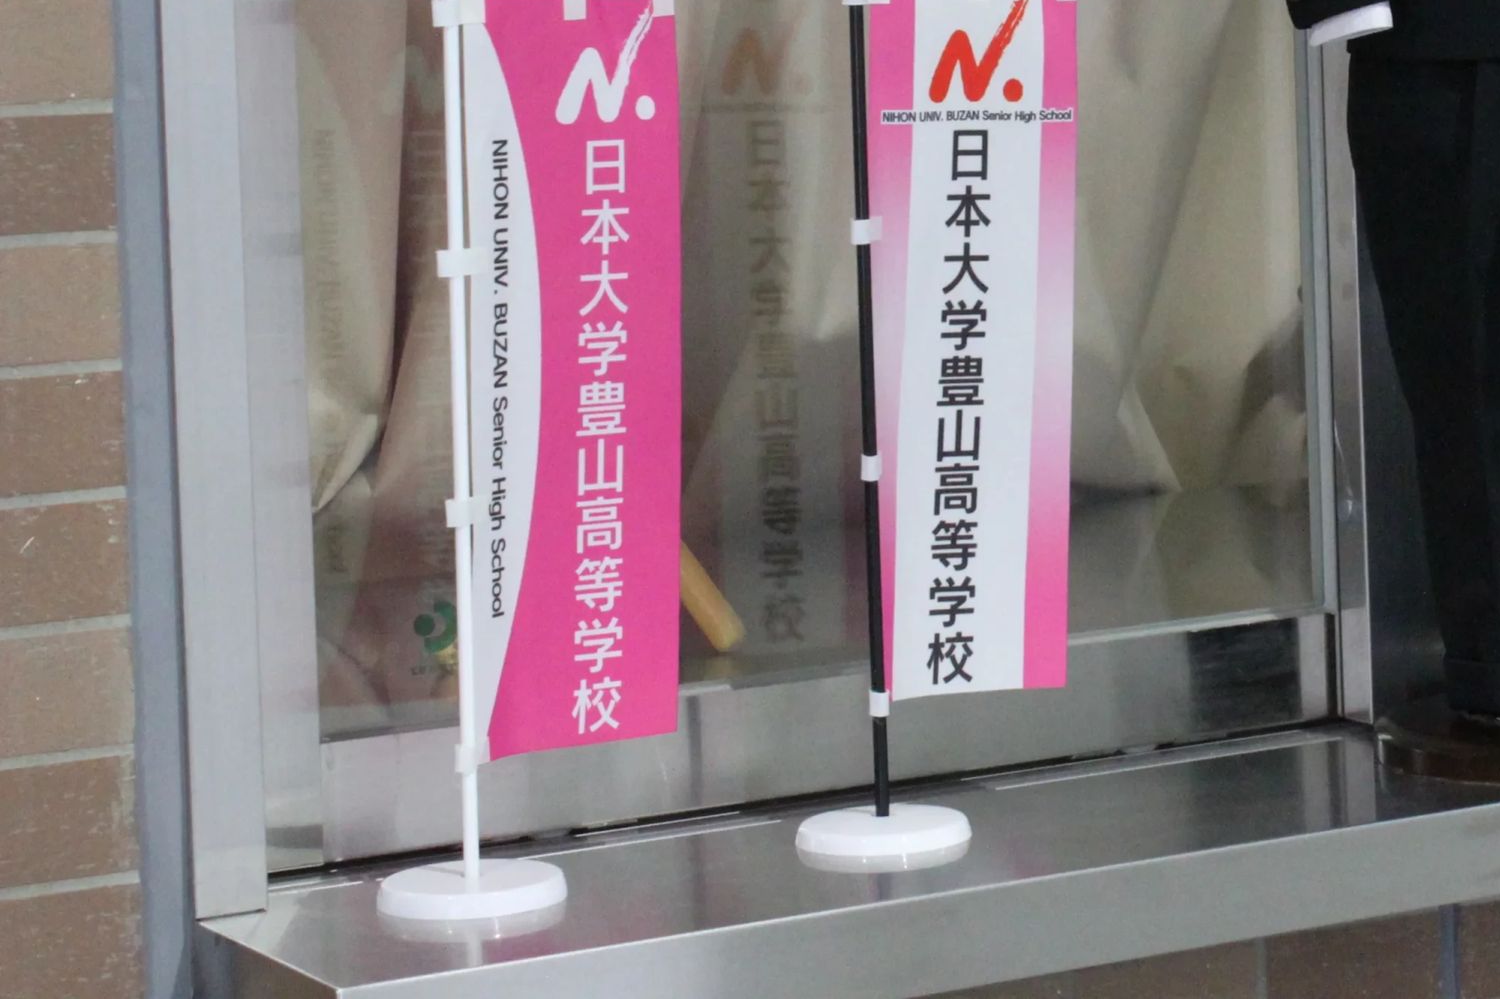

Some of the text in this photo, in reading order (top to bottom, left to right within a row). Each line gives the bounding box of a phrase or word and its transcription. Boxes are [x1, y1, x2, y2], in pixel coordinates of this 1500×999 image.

[882, 108, 1072, 124] NIHON UNIV. BUZAN Senior High School
[488, 139, 509, 619] NIHON UNIV. BUZAN Senior High School
[571, 138, 630, 735] 日本大学豊山高等学校
[926, 129, 991, 686] 日本大学豊山高等学校
